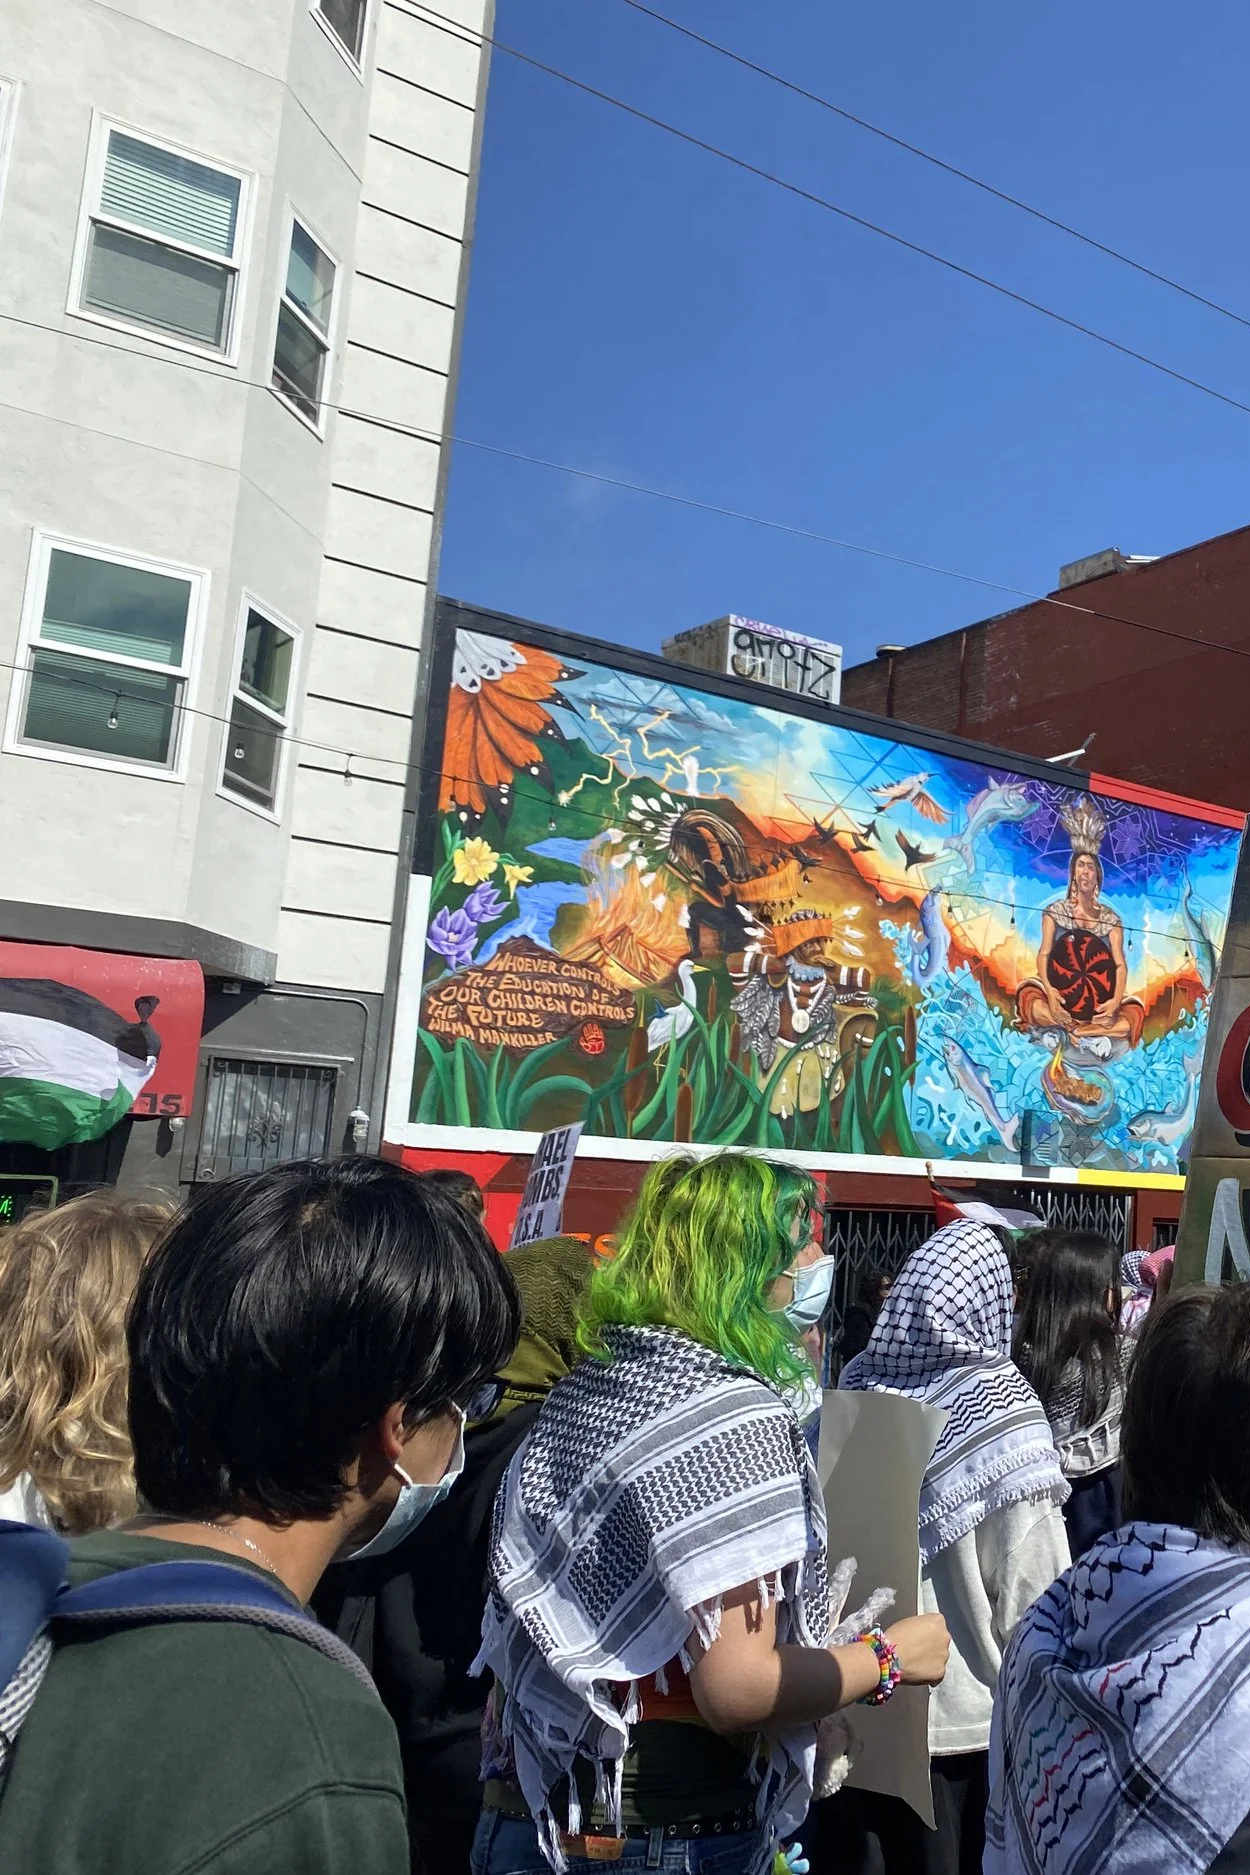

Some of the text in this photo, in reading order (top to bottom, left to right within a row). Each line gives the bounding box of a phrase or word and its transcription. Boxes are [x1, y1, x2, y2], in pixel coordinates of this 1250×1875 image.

[465, 971, 609, 1004] THE EDUCATION OF
[484, 952, 621, 996] WHOEVER CONTROLS
[428, 995, 544, 1028] THE FUTURE
[440, 986, 635, 1019] OUR CHILDREN CONTROLS
[428, 1017, 558, 1048] WILMA MANKILLER
